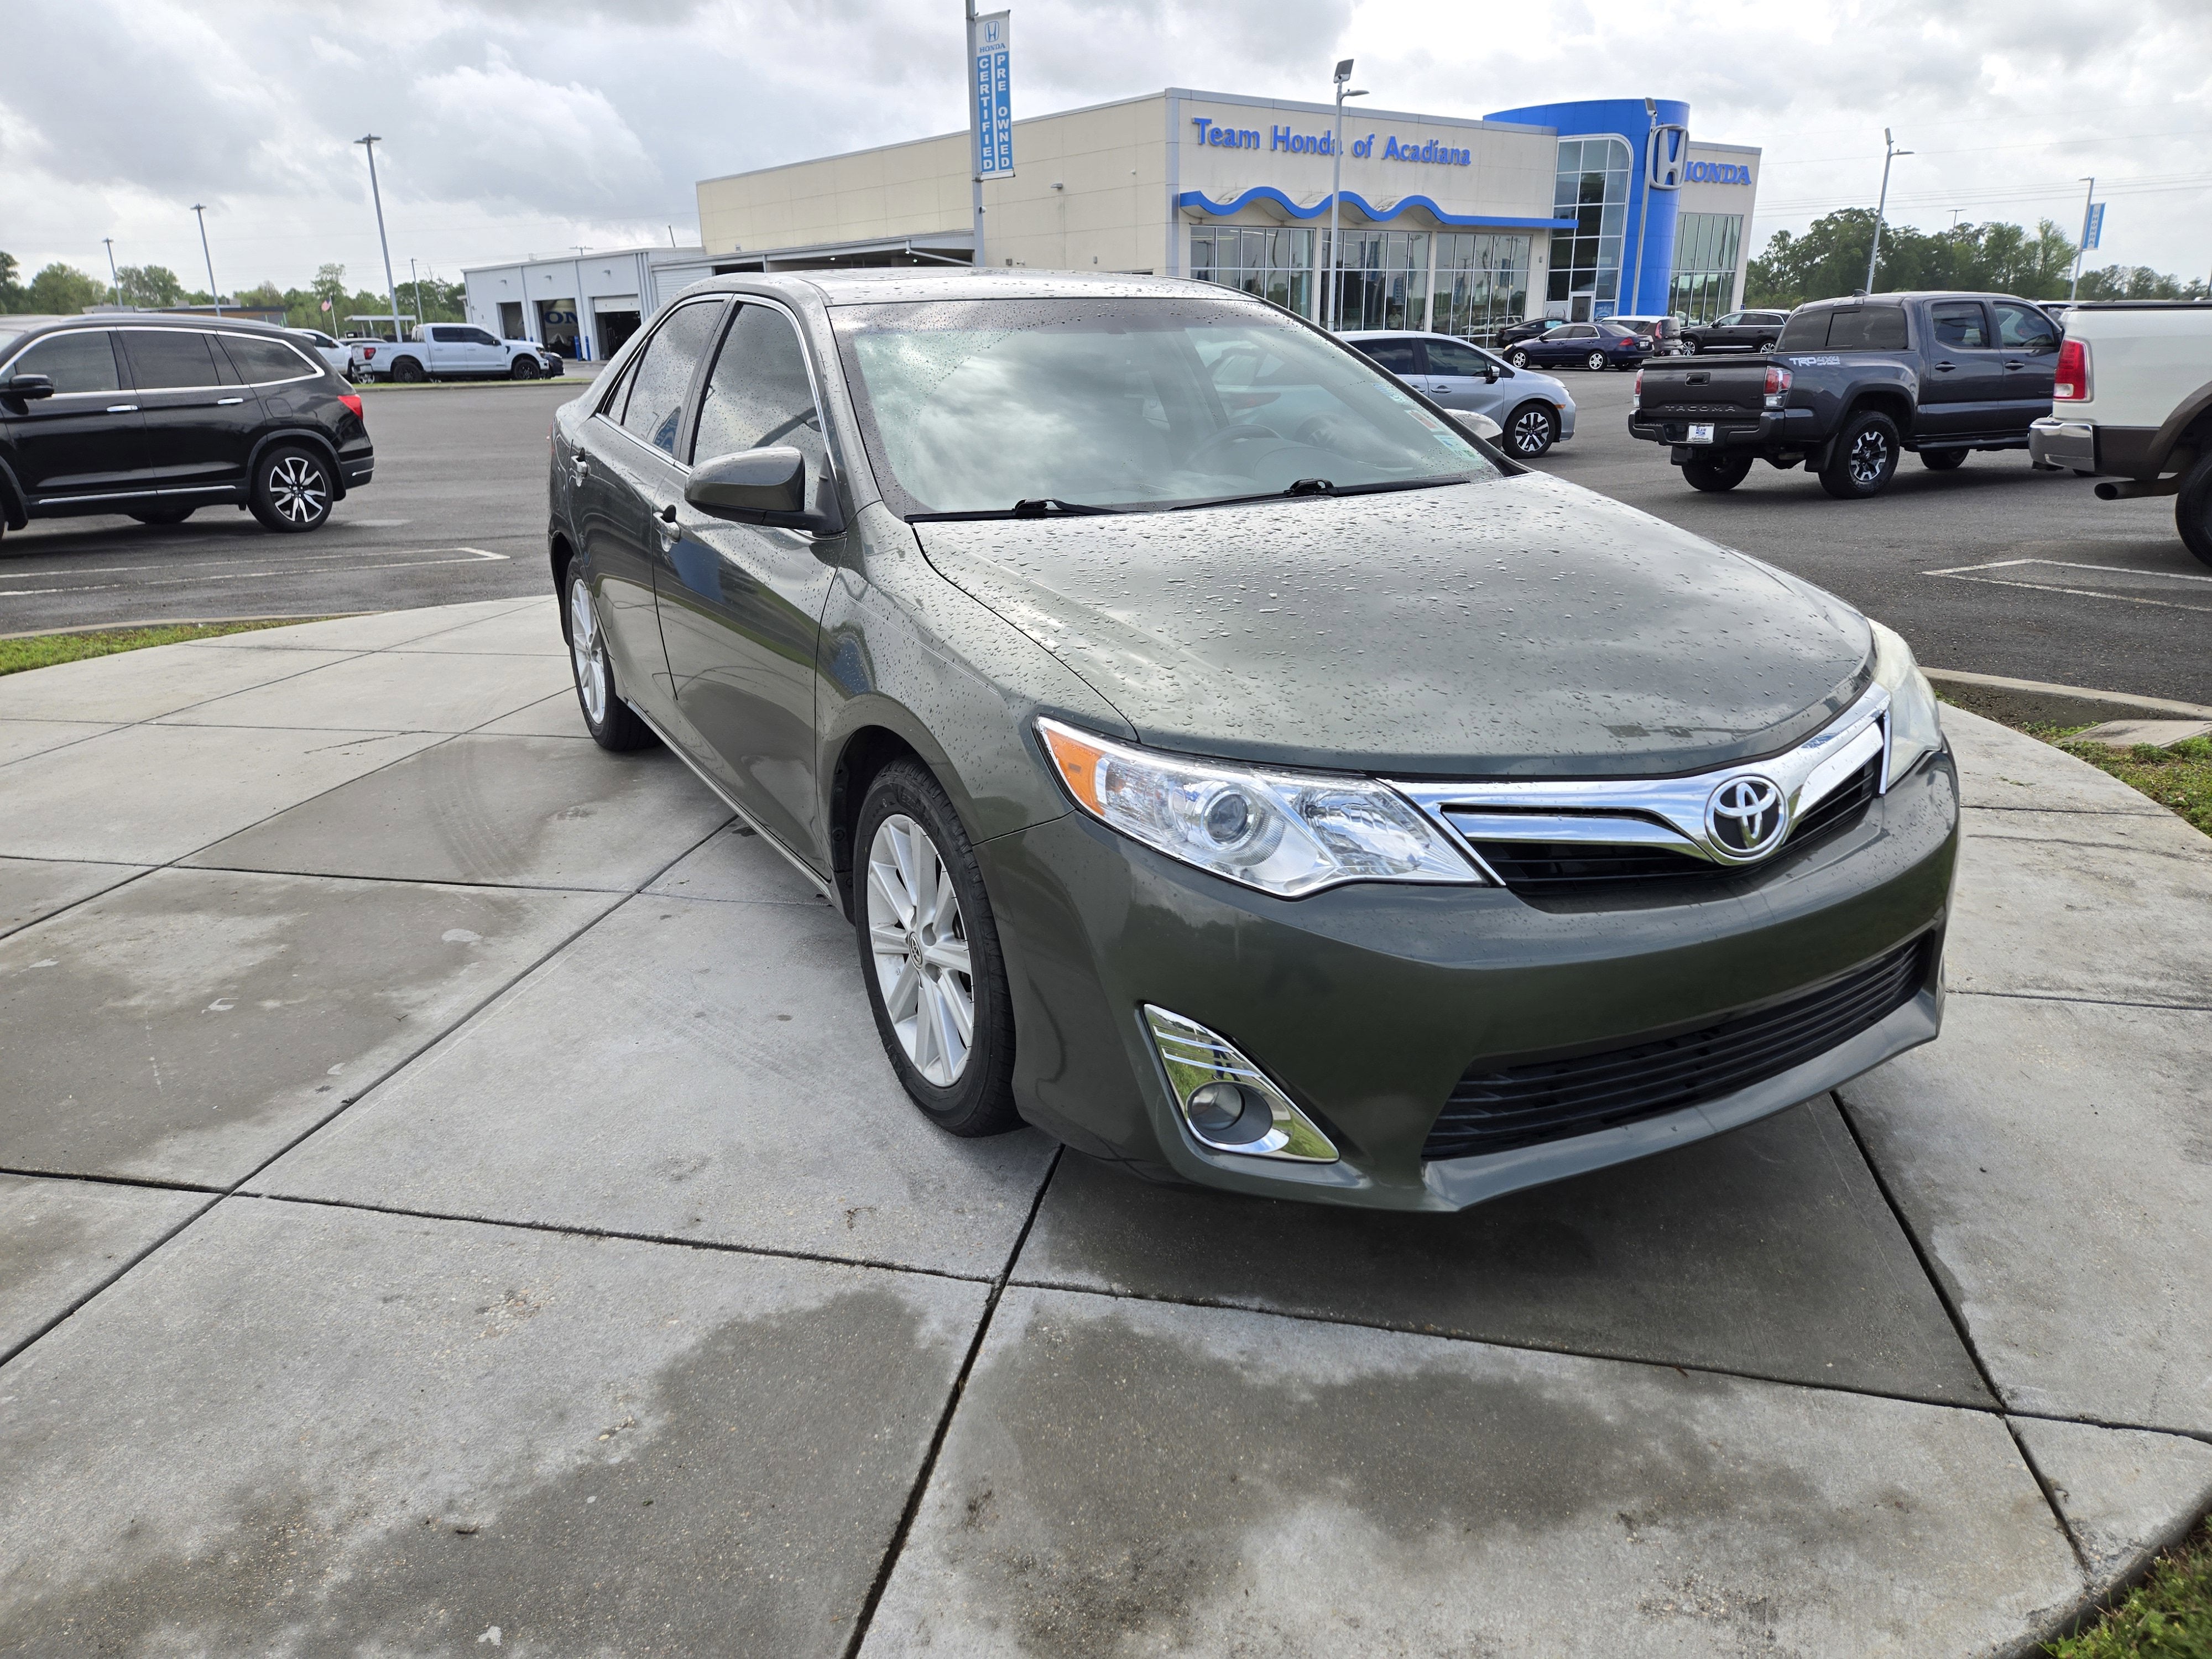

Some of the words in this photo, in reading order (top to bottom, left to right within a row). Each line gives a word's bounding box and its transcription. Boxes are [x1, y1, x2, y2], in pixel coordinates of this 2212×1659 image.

[979, 43, 1006, 53] HONDA
[997, 56, 1006, 91] PRE
[979, 58, 993, 169] CERTIFIED
[998, 106, 1010, 168] OWNED
[1192, 117, 1261, 149] Team
[1353, 134, 1376, 158] of
[1383, 136, 1472, 165] Acadiana
[1789, 357, 1817, 367] TRD
